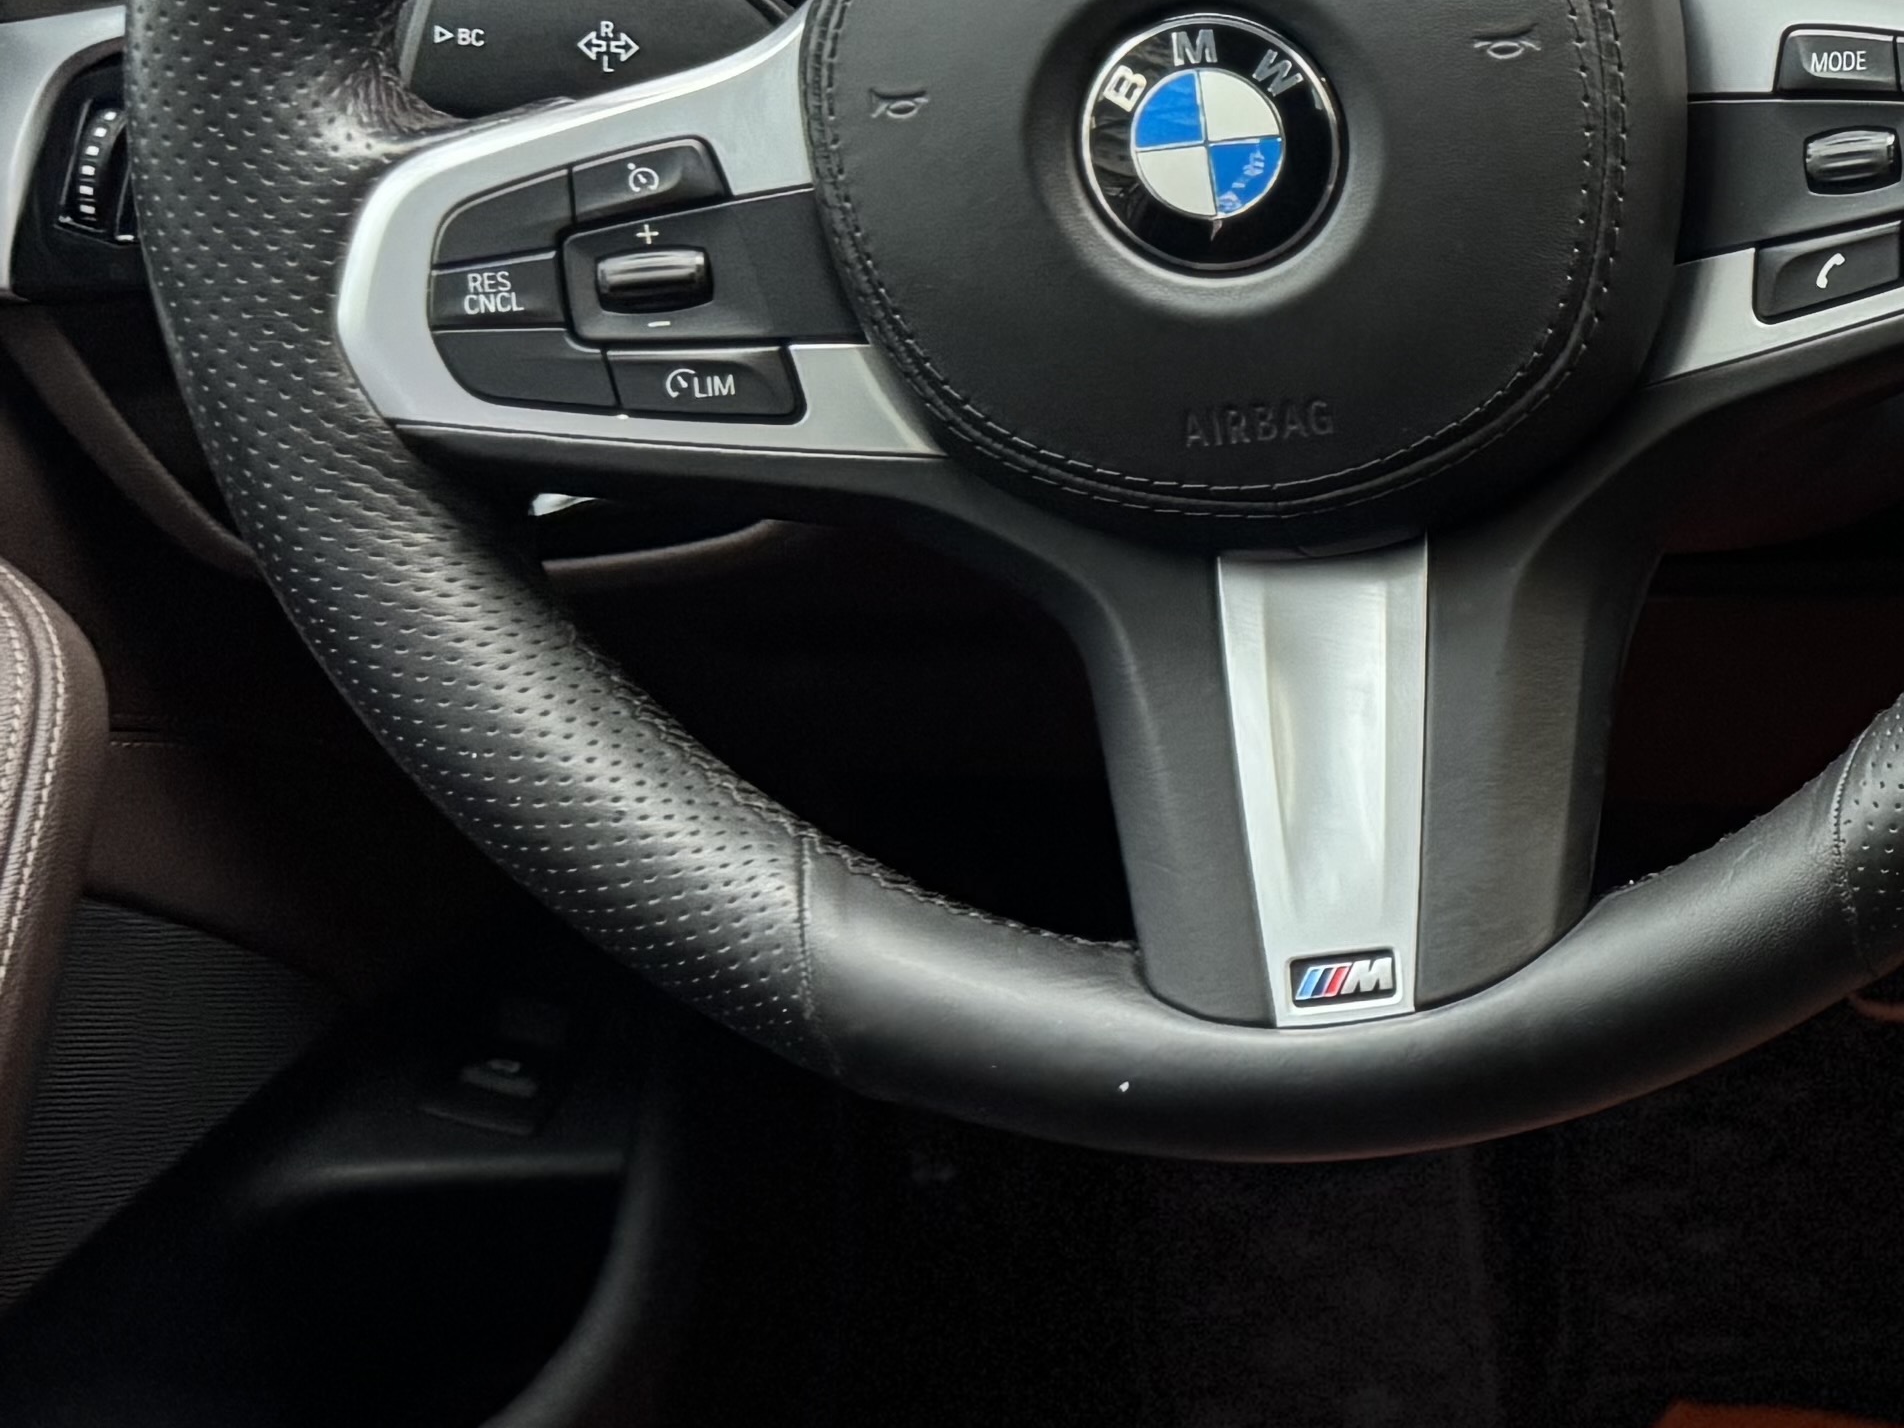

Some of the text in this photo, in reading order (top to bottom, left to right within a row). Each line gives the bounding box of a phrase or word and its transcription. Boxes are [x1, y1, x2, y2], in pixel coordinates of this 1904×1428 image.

[457, 28, 485, 47] BC
[600, 20, 615, 38] R
[603, 54, 615, 73] L
[1102, 28, 1304, 112] BMW
[1809, 50, 1867, 74] MODE
[467, 271, 512, 293] RES
[463, 292, 525, 315] CNCL
[693, 373, 737, 399] LIM
[1186, 401, 1334, 448] AIRBAG
